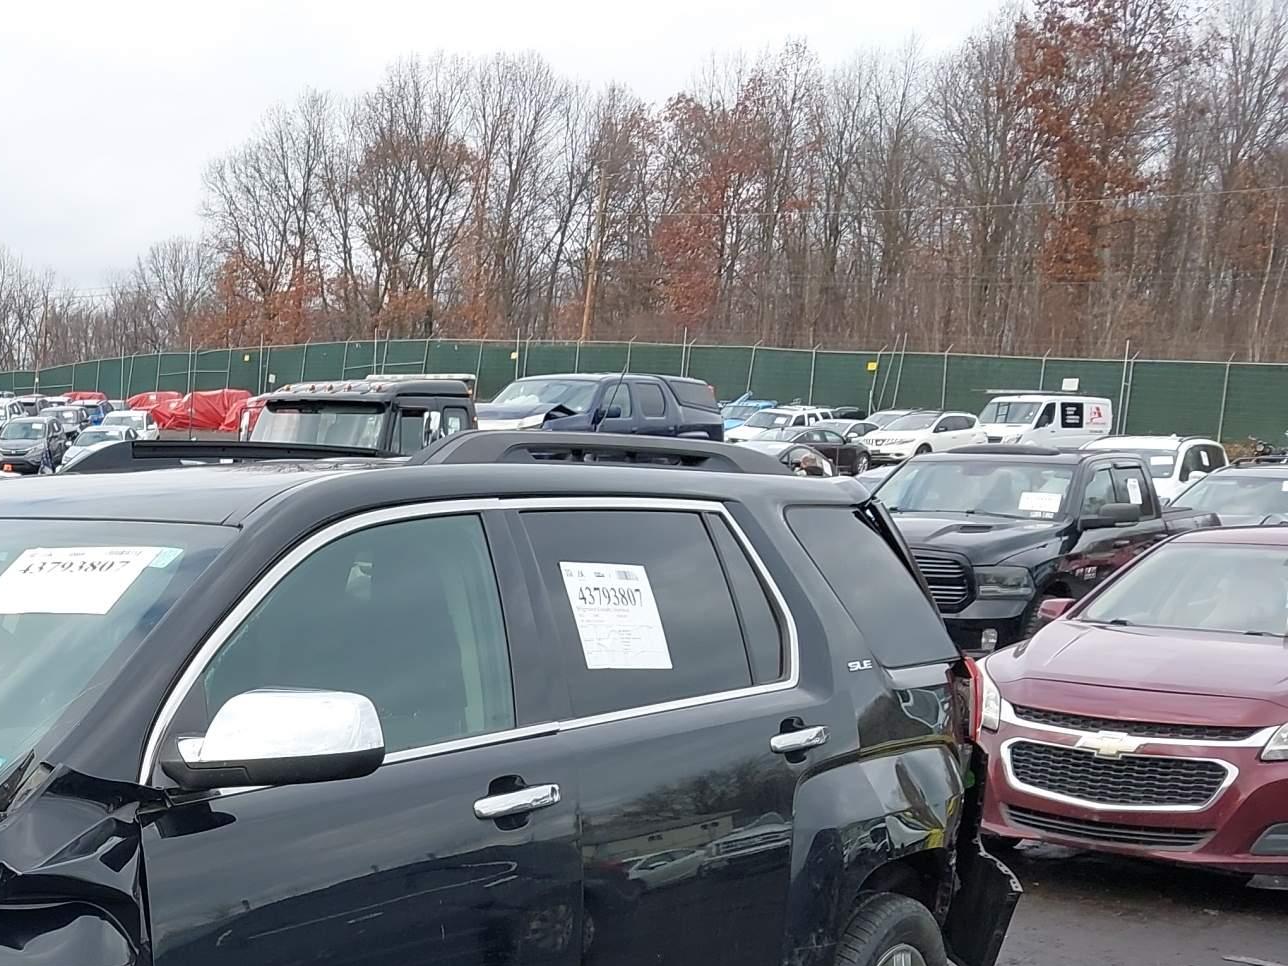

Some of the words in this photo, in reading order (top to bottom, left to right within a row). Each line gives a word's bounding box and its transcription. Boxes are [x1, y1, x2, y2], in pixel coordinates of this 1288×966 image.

[19, 560, 132, 575] 43793807
[578, 586, 643, 608] 43793807
[847, 659, 873, 672] SLE
